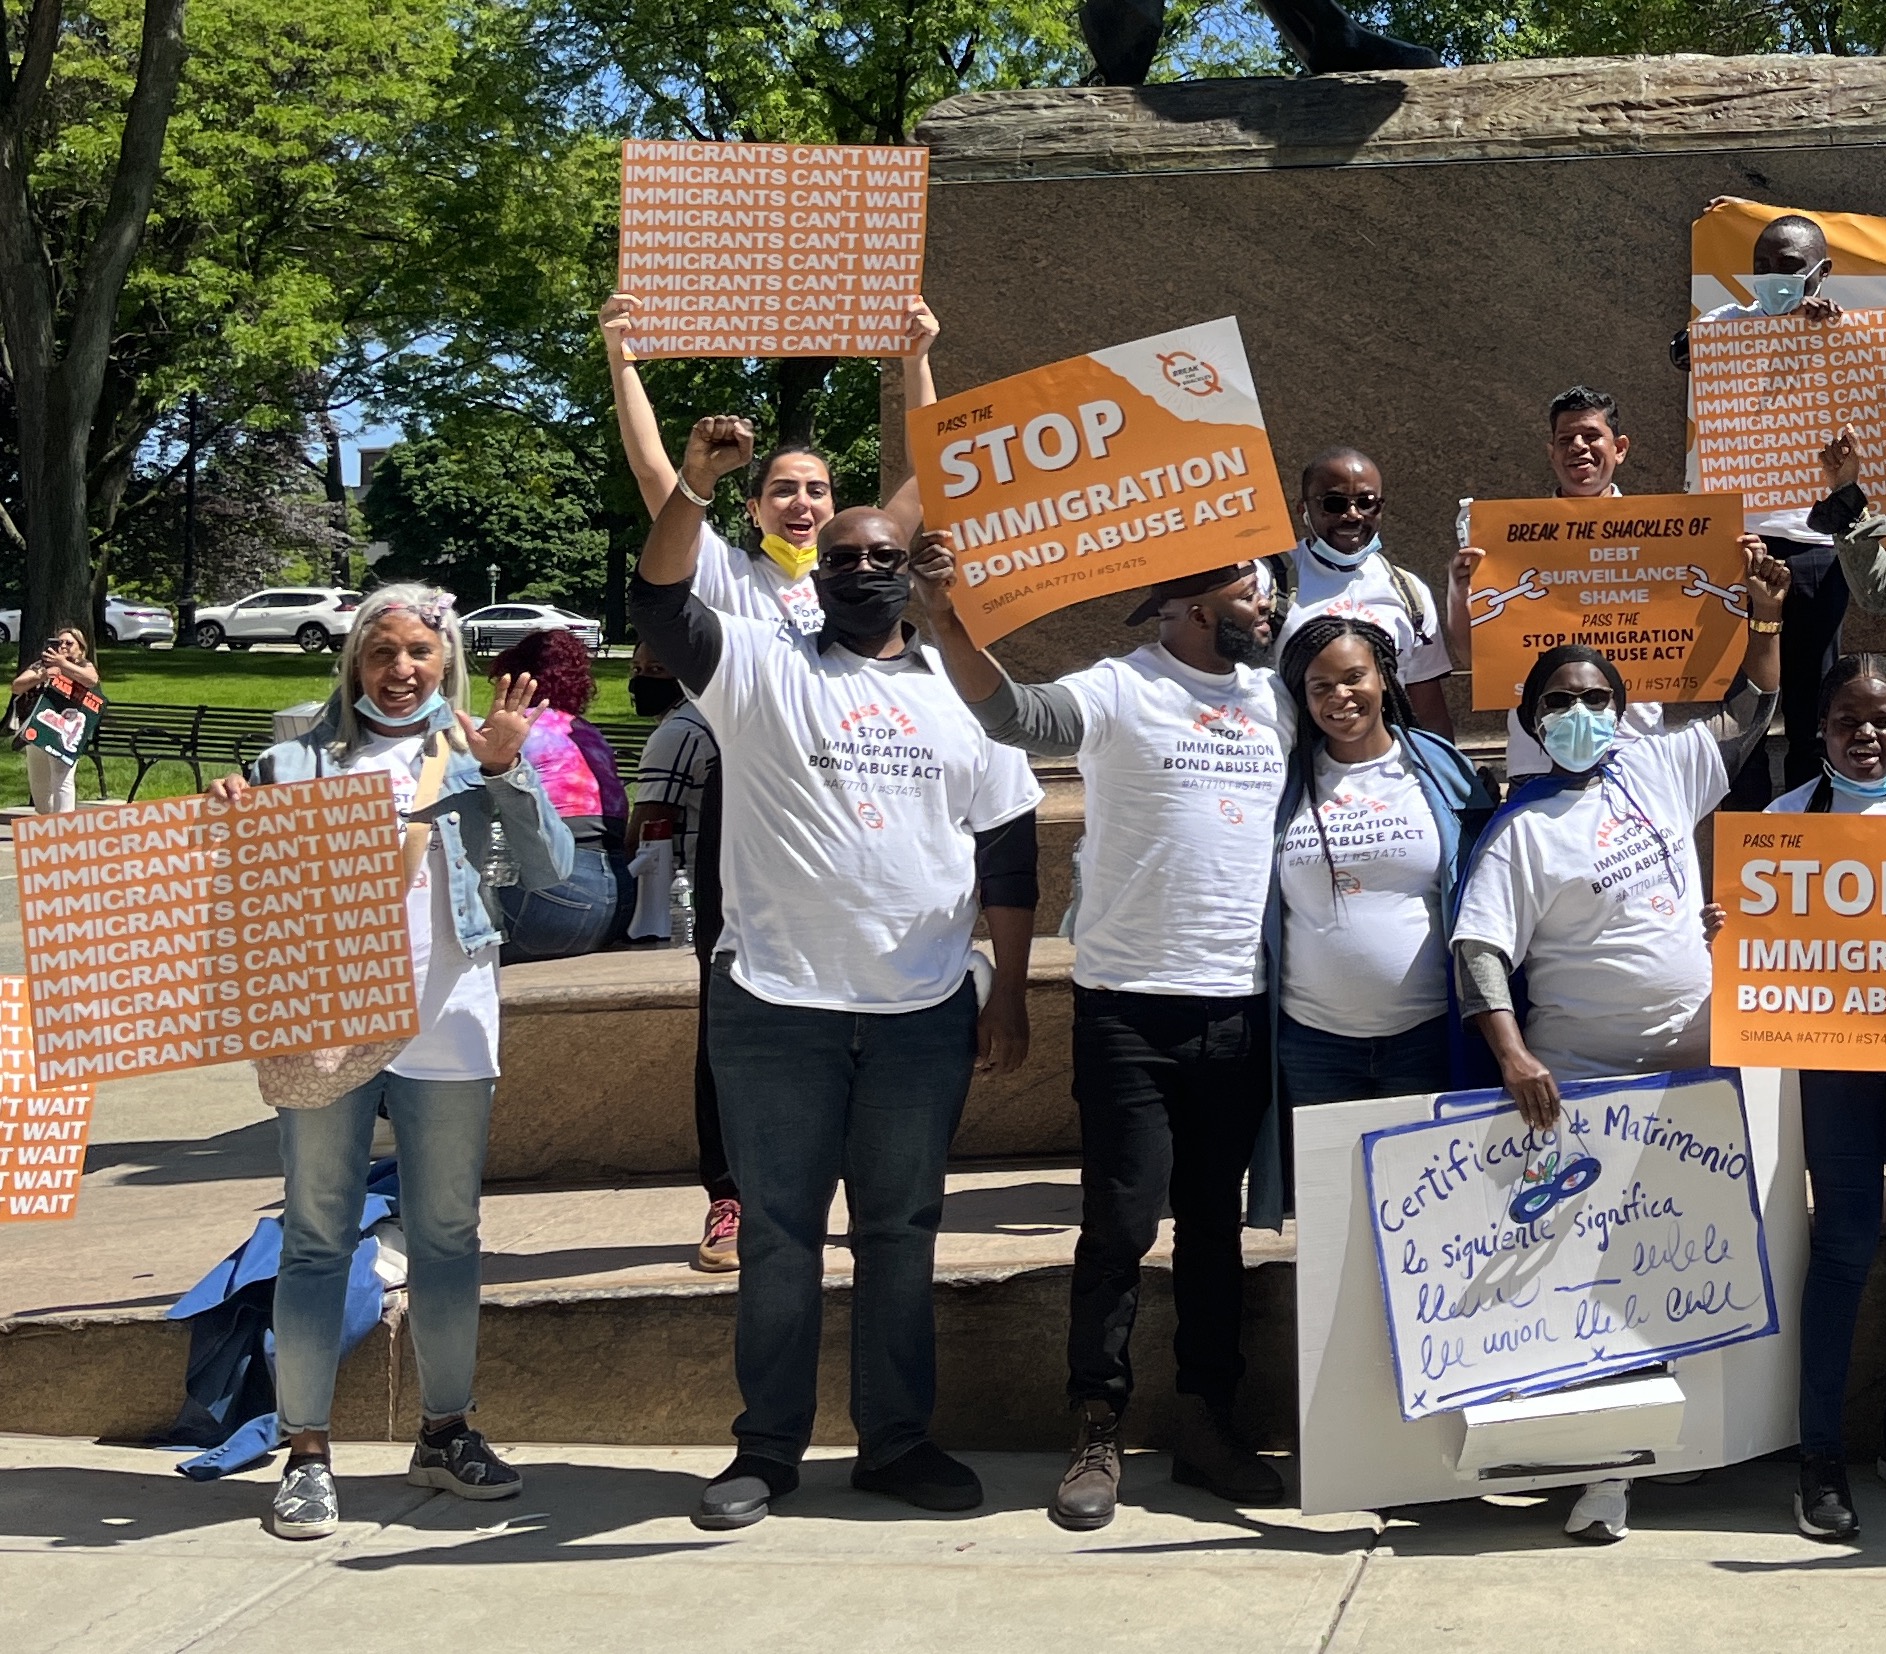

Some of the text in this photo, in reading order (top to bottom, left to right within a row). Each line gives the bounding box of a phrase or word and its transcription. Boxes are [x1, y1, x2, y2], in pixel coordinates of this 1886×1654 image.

[627, 143, 926, 166] IMMIGRANTS CAN'T WAIT
[626, 165, 924, 187] IMMIGRANTS CAN'T WAIT
[1692, 334, 1824, 358] IMMIGRANTS
[1827, 328, 1886, 348] CAN'T
[1694, 354, 1826, 377] IMMIGRANTS
[937, 404, 994, 436] PASS THE
[940, 399, 1125, 498] STOP
[950, 446, 1248, 552] IMMIGRATION
[962, 487, 1257, 588] BOND ABUSE ACT
[1507, 517, 1712, 543] BREAK THE SHACKLES OF
[1589, 546, 1640, 563] DEBT
[982, 586, 1033, 615] SIMBAA
[1036, 571, 1086, 590] #A7770
[1097, 556, 1147, 577] #S7475
[1539, 565, 1688, 586] SURVEILLANCE
[1579, 588, 1650, 606] SHAME
[1582, 612, 1640, 627] PASS THE
[1522, 628, 1694, 648] STOP IMMIGRATION
[1653, 646, 1685, 659] ACT
[1645, 677, 1699, 691] #S7475
[857, 726, 898, 740] STOP
[889, 706, 918, 737] THE
[822, 738, 934, 760] IMMIGRATION
[808, 755, 944, 780] BOND ABUSE ACT
[21, 800, 392, 868] IMMIGRANTS CAN'T WAIT
[1742, 834, 1804, 848] PASS THE
[23, 825, 394, 895] IMMIGRANTS CAN'T WAIT
[1737, 984, 1834, 1013] BOND
[1740, 1029, 1793, 1043] SIMBAA
[1796, 1031, 1845, 1044] #A7770
[1380, 1124, 1559, 1233] Certificado
[1569, 1108, 1591, 1136] de
